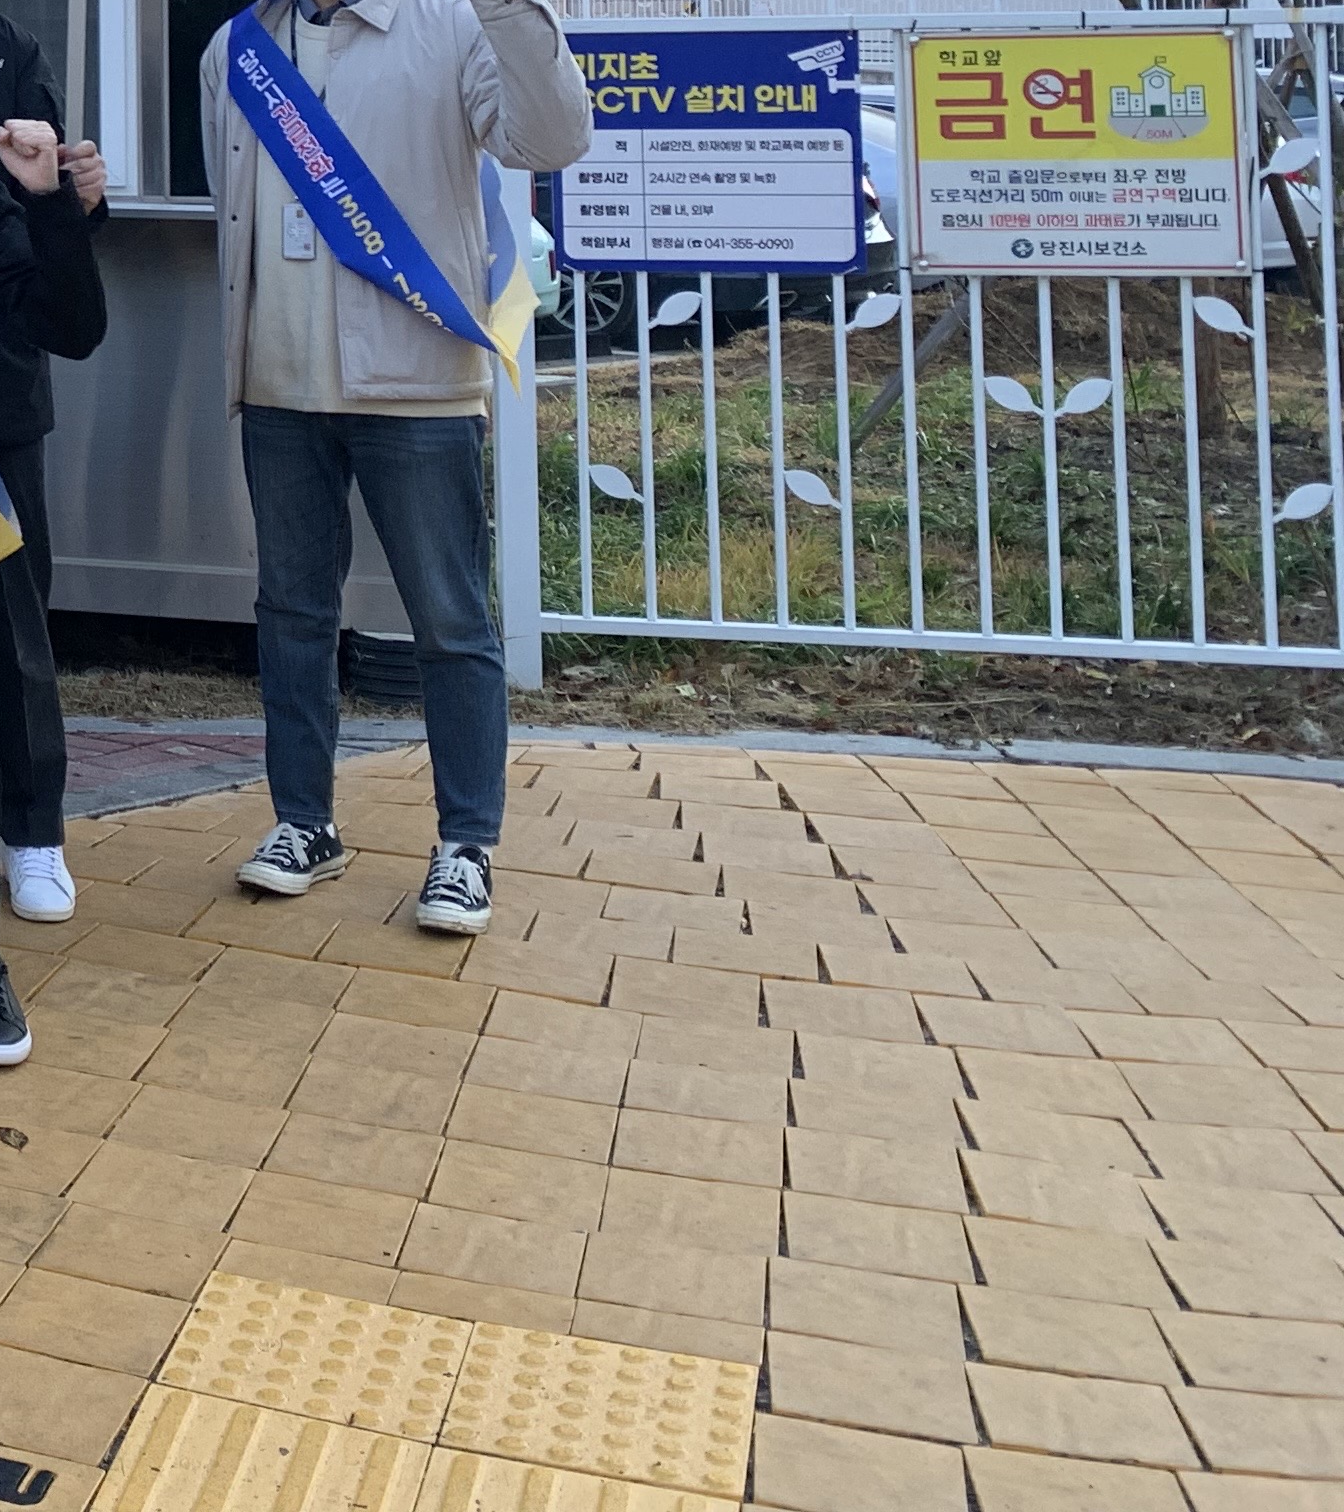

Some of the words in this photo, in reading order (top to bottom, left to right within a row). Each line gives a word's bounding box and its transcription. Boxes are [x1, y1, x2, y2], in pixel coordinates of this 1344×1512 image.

[816, 44, 841, 58] CCTV
[939, 48, 1002, 67] 학교앞
[684, 85, 745, 113] 설치
[754, 84, 818, 113] 안내
[935, 67, 1097, 140] 금연
[1147, 129, 1173, 139] 50M
[759, 139, 805, 152] 학교폭력
[578, 171, 629, 185] 촬영시간
[649, 172, 687, 185] 24시간
[689, 172, 711, 185] 연속
[714, 172, 737, 185] 촬영
[739, 172, 751, 185] 및
[970, 169, 1001, 184] 학교
[1008, 169, 1106, 185] 출입문으로부터
[1154, 168, 1187, 184] 전방
[930, 188, 1025, 204] 도로직선거리
[1031, 188, 1063, 203] 50m
[1069, 190, 1107, 203] 이내는
[580, 204, 630, 217] 촬영범위
[650, 204, 672, 216] 건물
[691, 204, 714, 216] 외부
[989, 214, 1031, 228] 10만원
[1037, 214, 1078, 228] 이하의
[1085, 213, 1141, 228] 과태료가
[580, 237, 631, 249] 책임부서
[651, 237, 684, 249] 행정실
[1040, 240, 1148, 257] 당진시보건소
